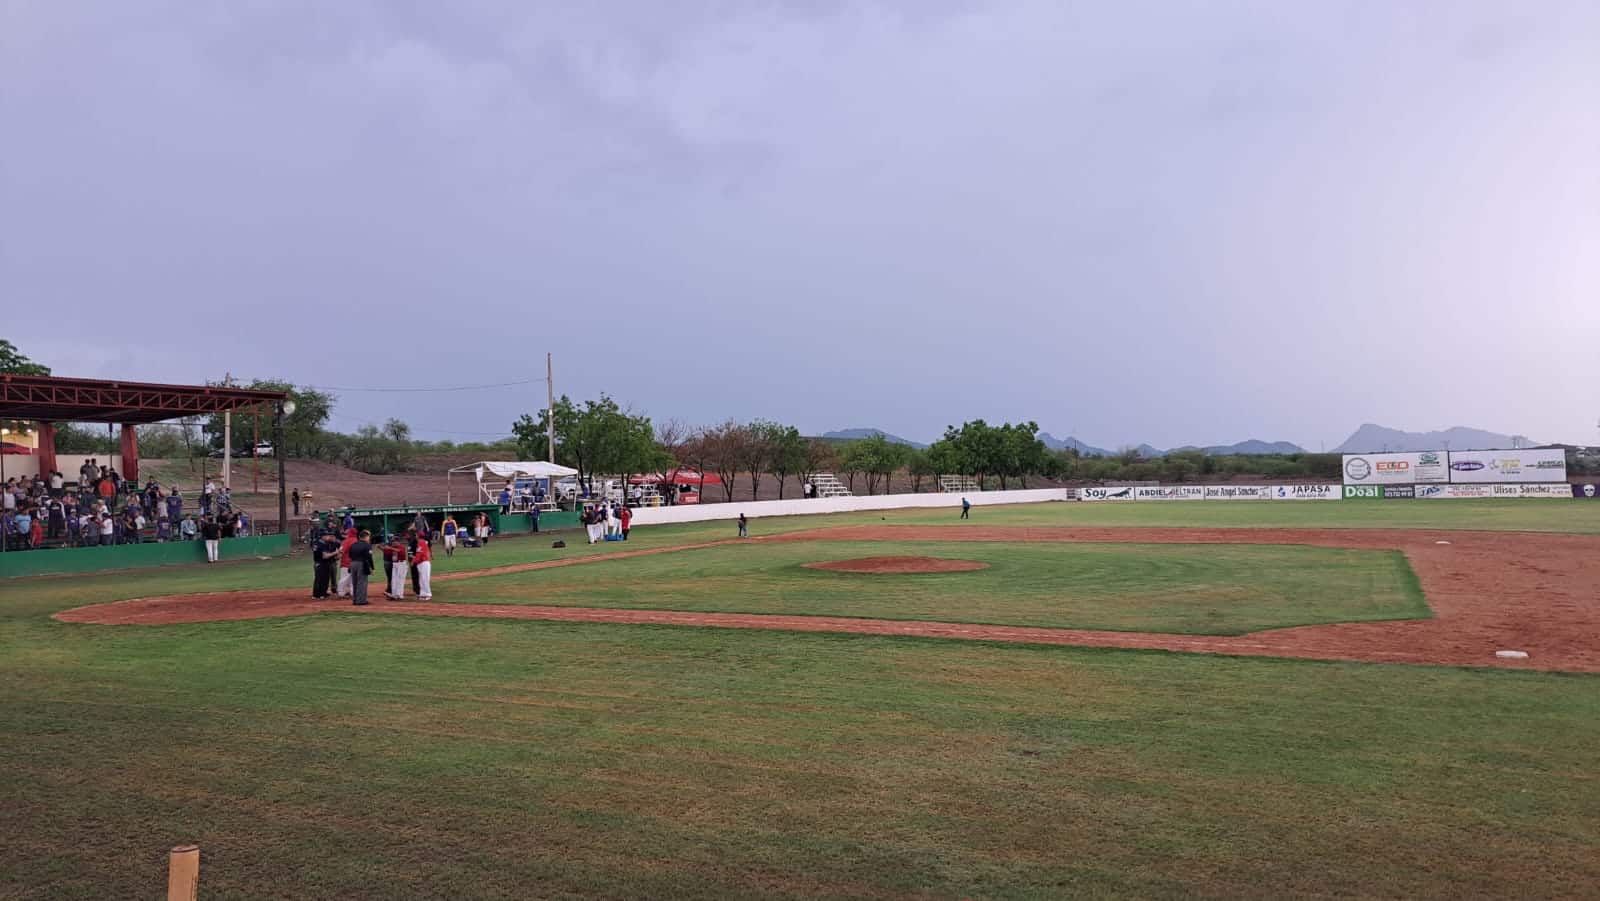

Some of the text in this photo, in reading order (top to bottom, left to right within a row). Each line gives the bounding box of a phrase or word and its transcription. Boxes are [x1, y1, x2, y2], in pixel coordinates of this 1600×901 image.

[1084, 488, 1106, 499] Soy
[1139, 488, 1168, 496] ABDIEL
[1292, 485, 1330, 494] JAPASA
[1494, 485, 1517, 494] Ulises
